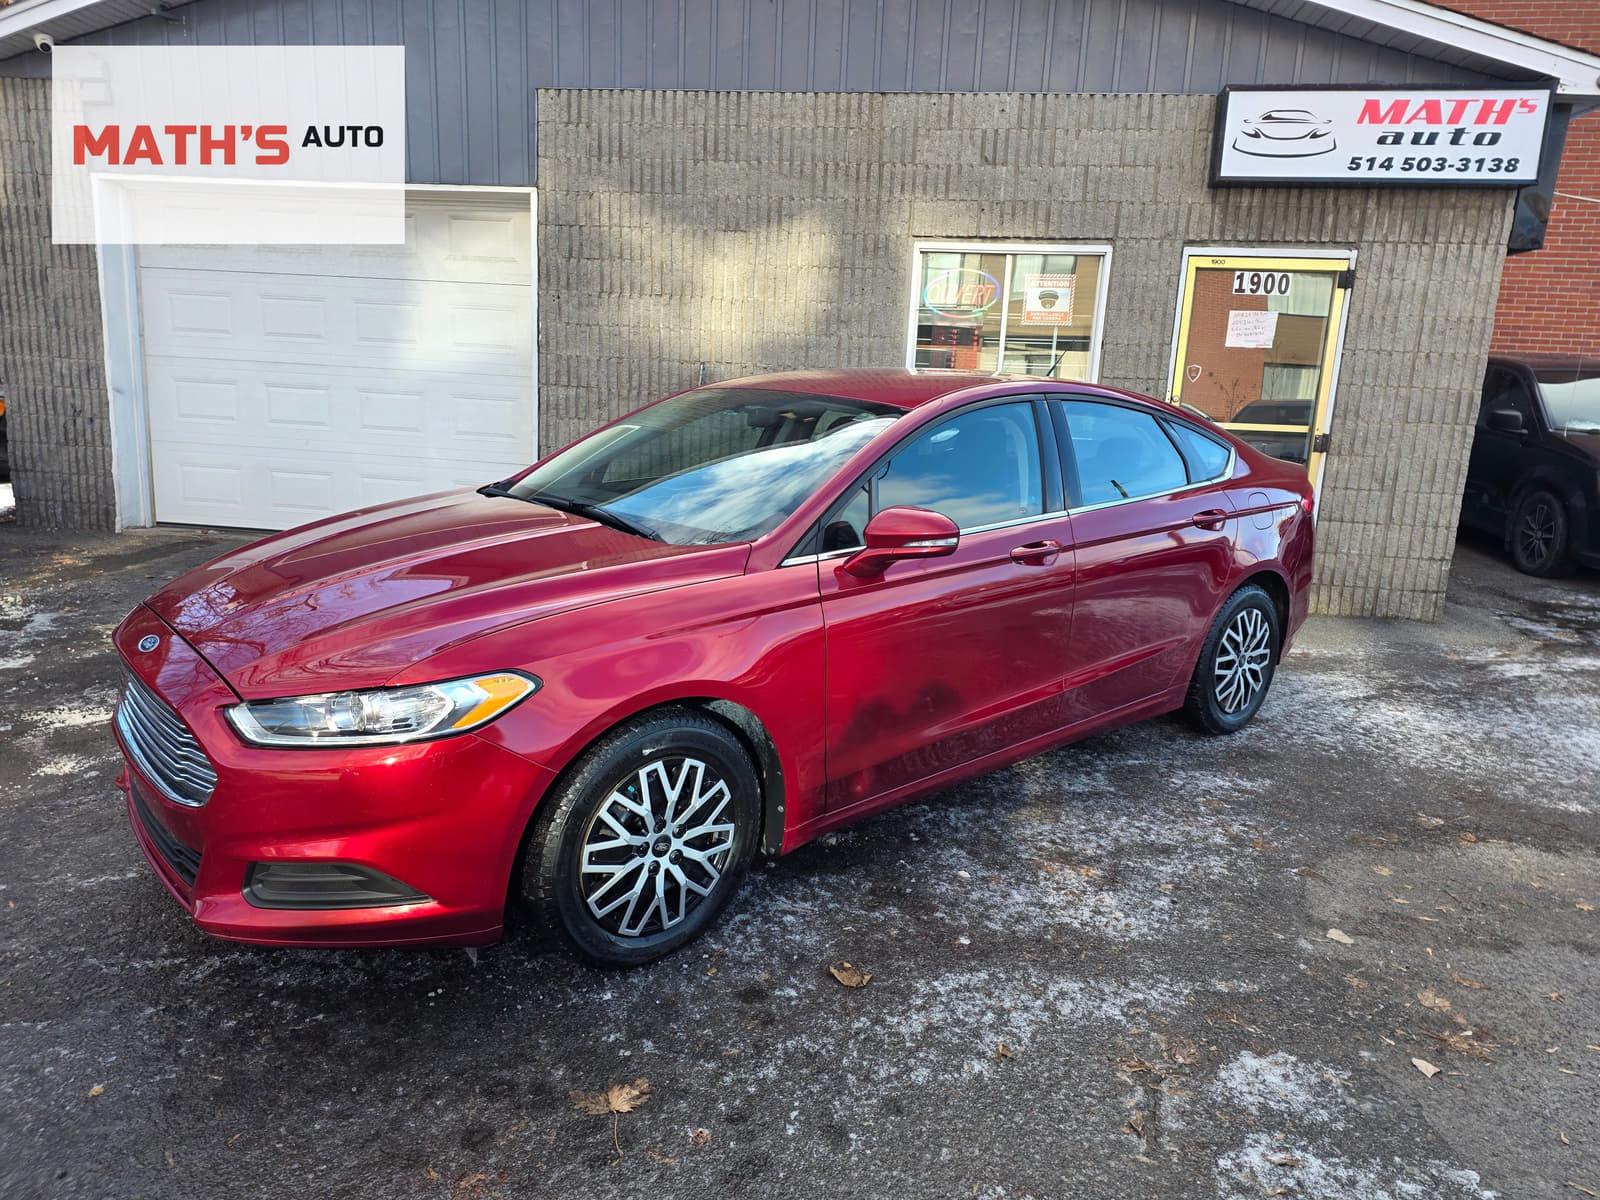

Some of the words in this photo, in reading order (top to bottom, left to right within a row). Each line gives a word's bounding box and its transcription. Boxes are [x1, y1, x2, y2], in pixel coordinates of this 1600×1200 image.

[1376, 127, 1502, 146] auto
[1347, 156, 1394, 171] 514
[1400, 157, 1520, 173] 503-3138
[1234, 272, 1290, 295] 1900
